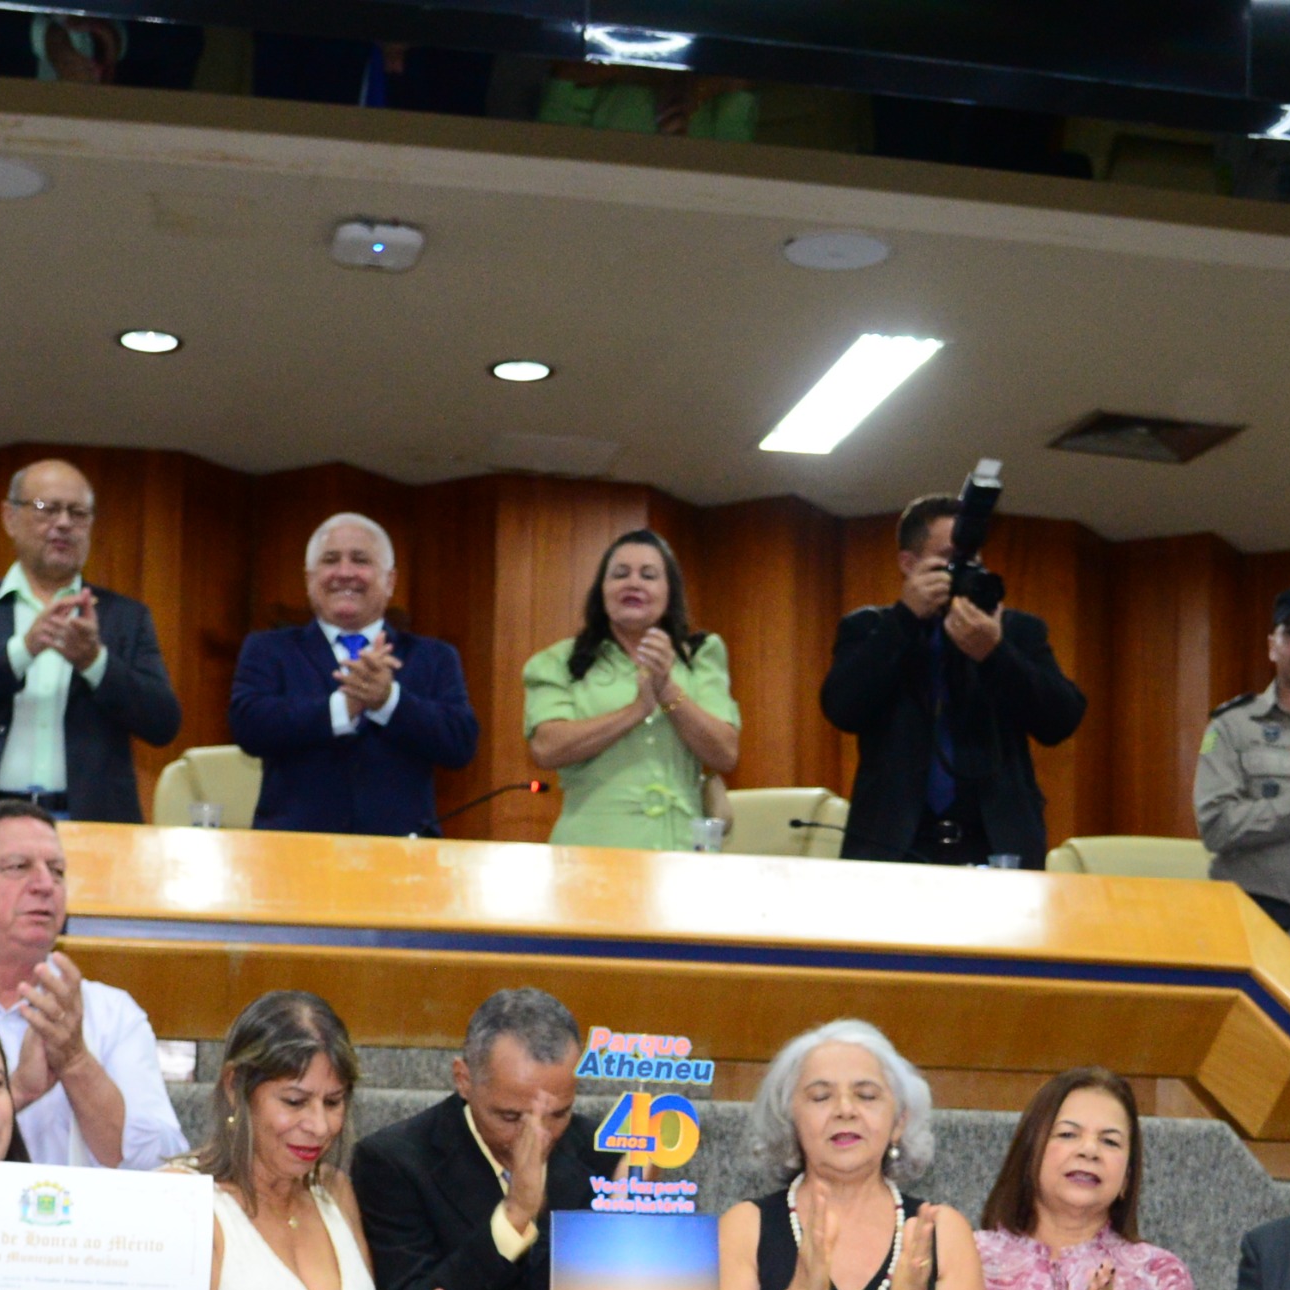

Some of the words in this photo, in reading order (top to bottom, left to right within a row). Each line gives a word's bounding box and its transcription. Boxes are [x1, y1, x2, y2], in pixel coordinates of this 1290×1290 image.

[590, 1027, 692, 1058] Parque
[577, 1051, 714, 1083] Atheneu
[595, 1092, 699, 1168] 40
[605, 1136, 648, 1149] anos
[1, 1231, 18, 1245] de
[26, 1231, 78, 1249] Honra
[83, 1237, 101, 1249] ao
[109, 1235, 164, 1253] Mérito
